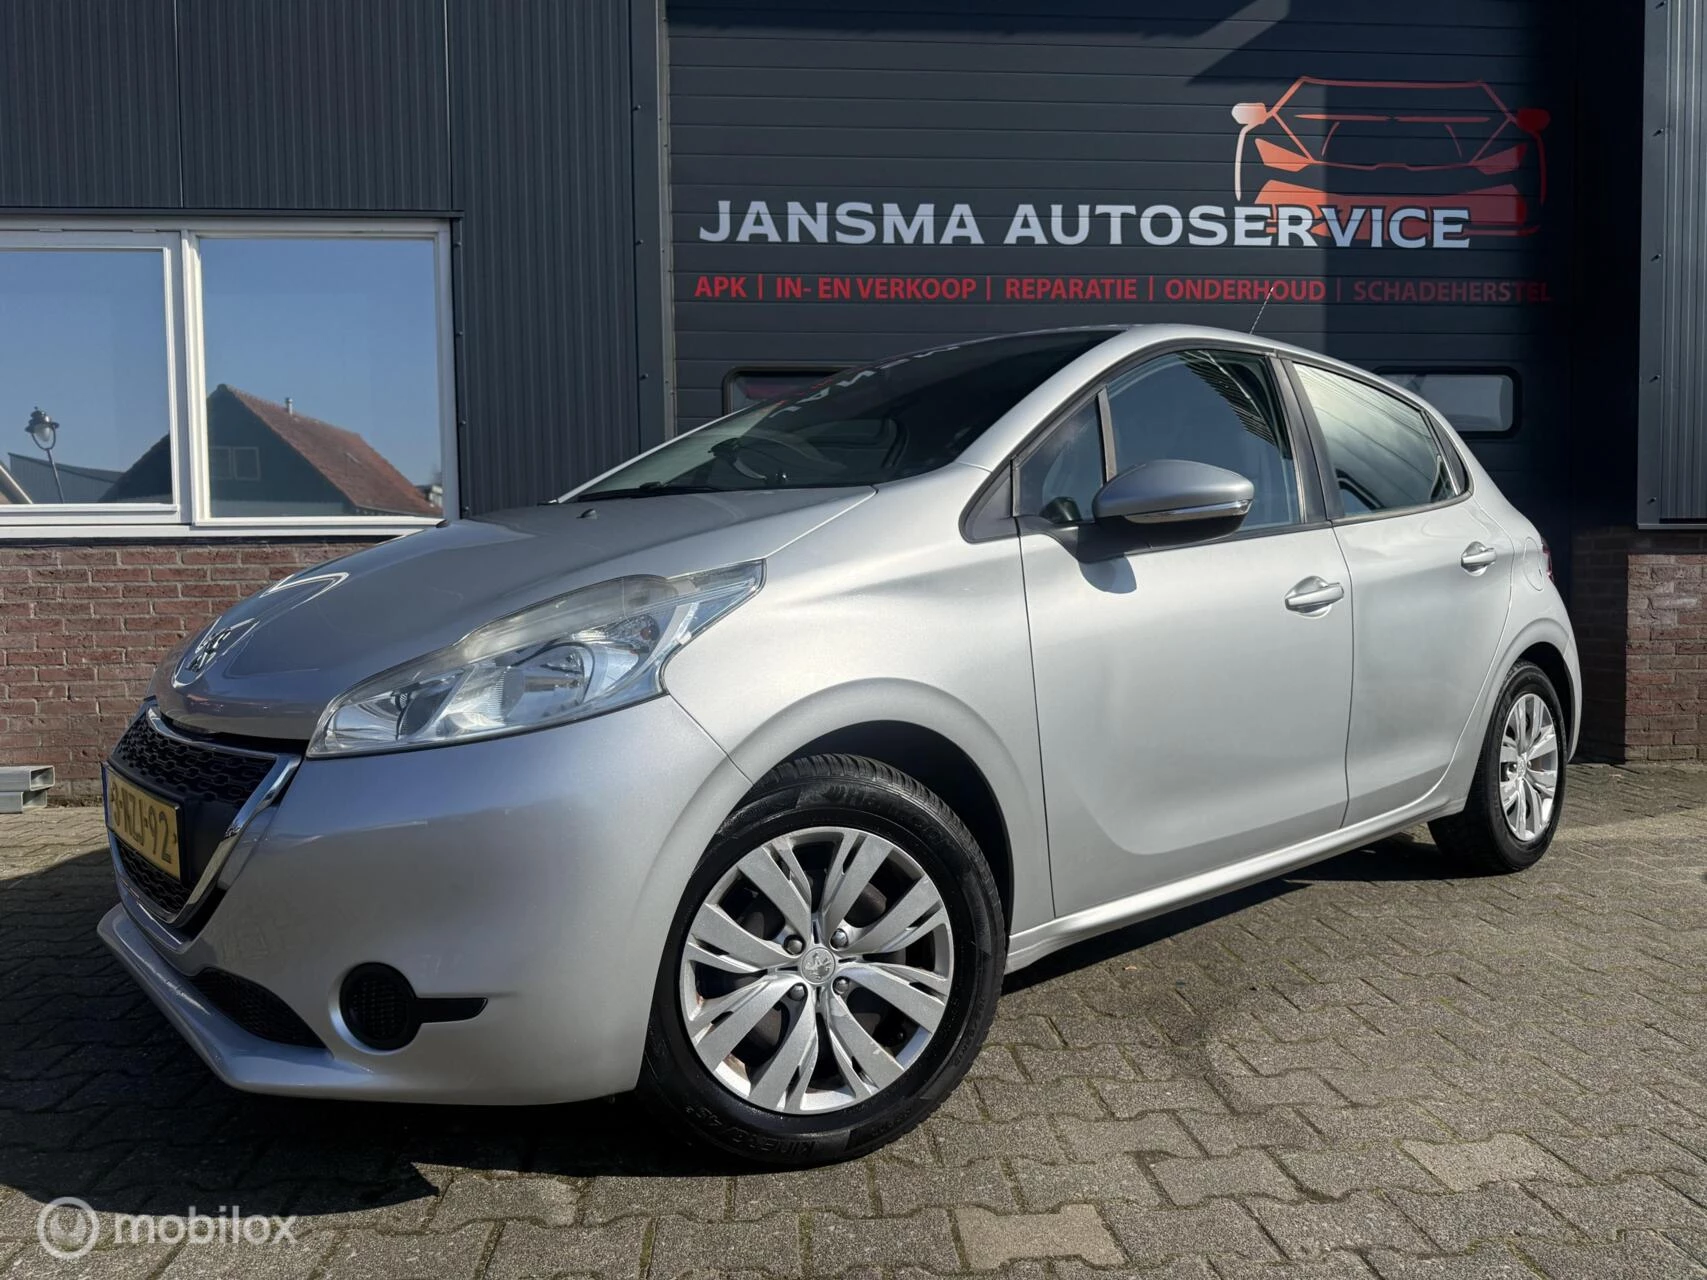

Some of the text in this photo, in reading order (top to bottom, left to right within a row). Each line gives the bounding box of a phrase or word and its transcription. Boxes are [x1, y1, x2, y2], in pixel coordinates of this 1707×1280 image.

[699, 200, 1471, 249] JANSMA AUTOSERVICE
[694, 276, 1551, 303] APK IN- EN VERKOOP REPARATIE ONDERHOUD SCHADEHERSTEL
